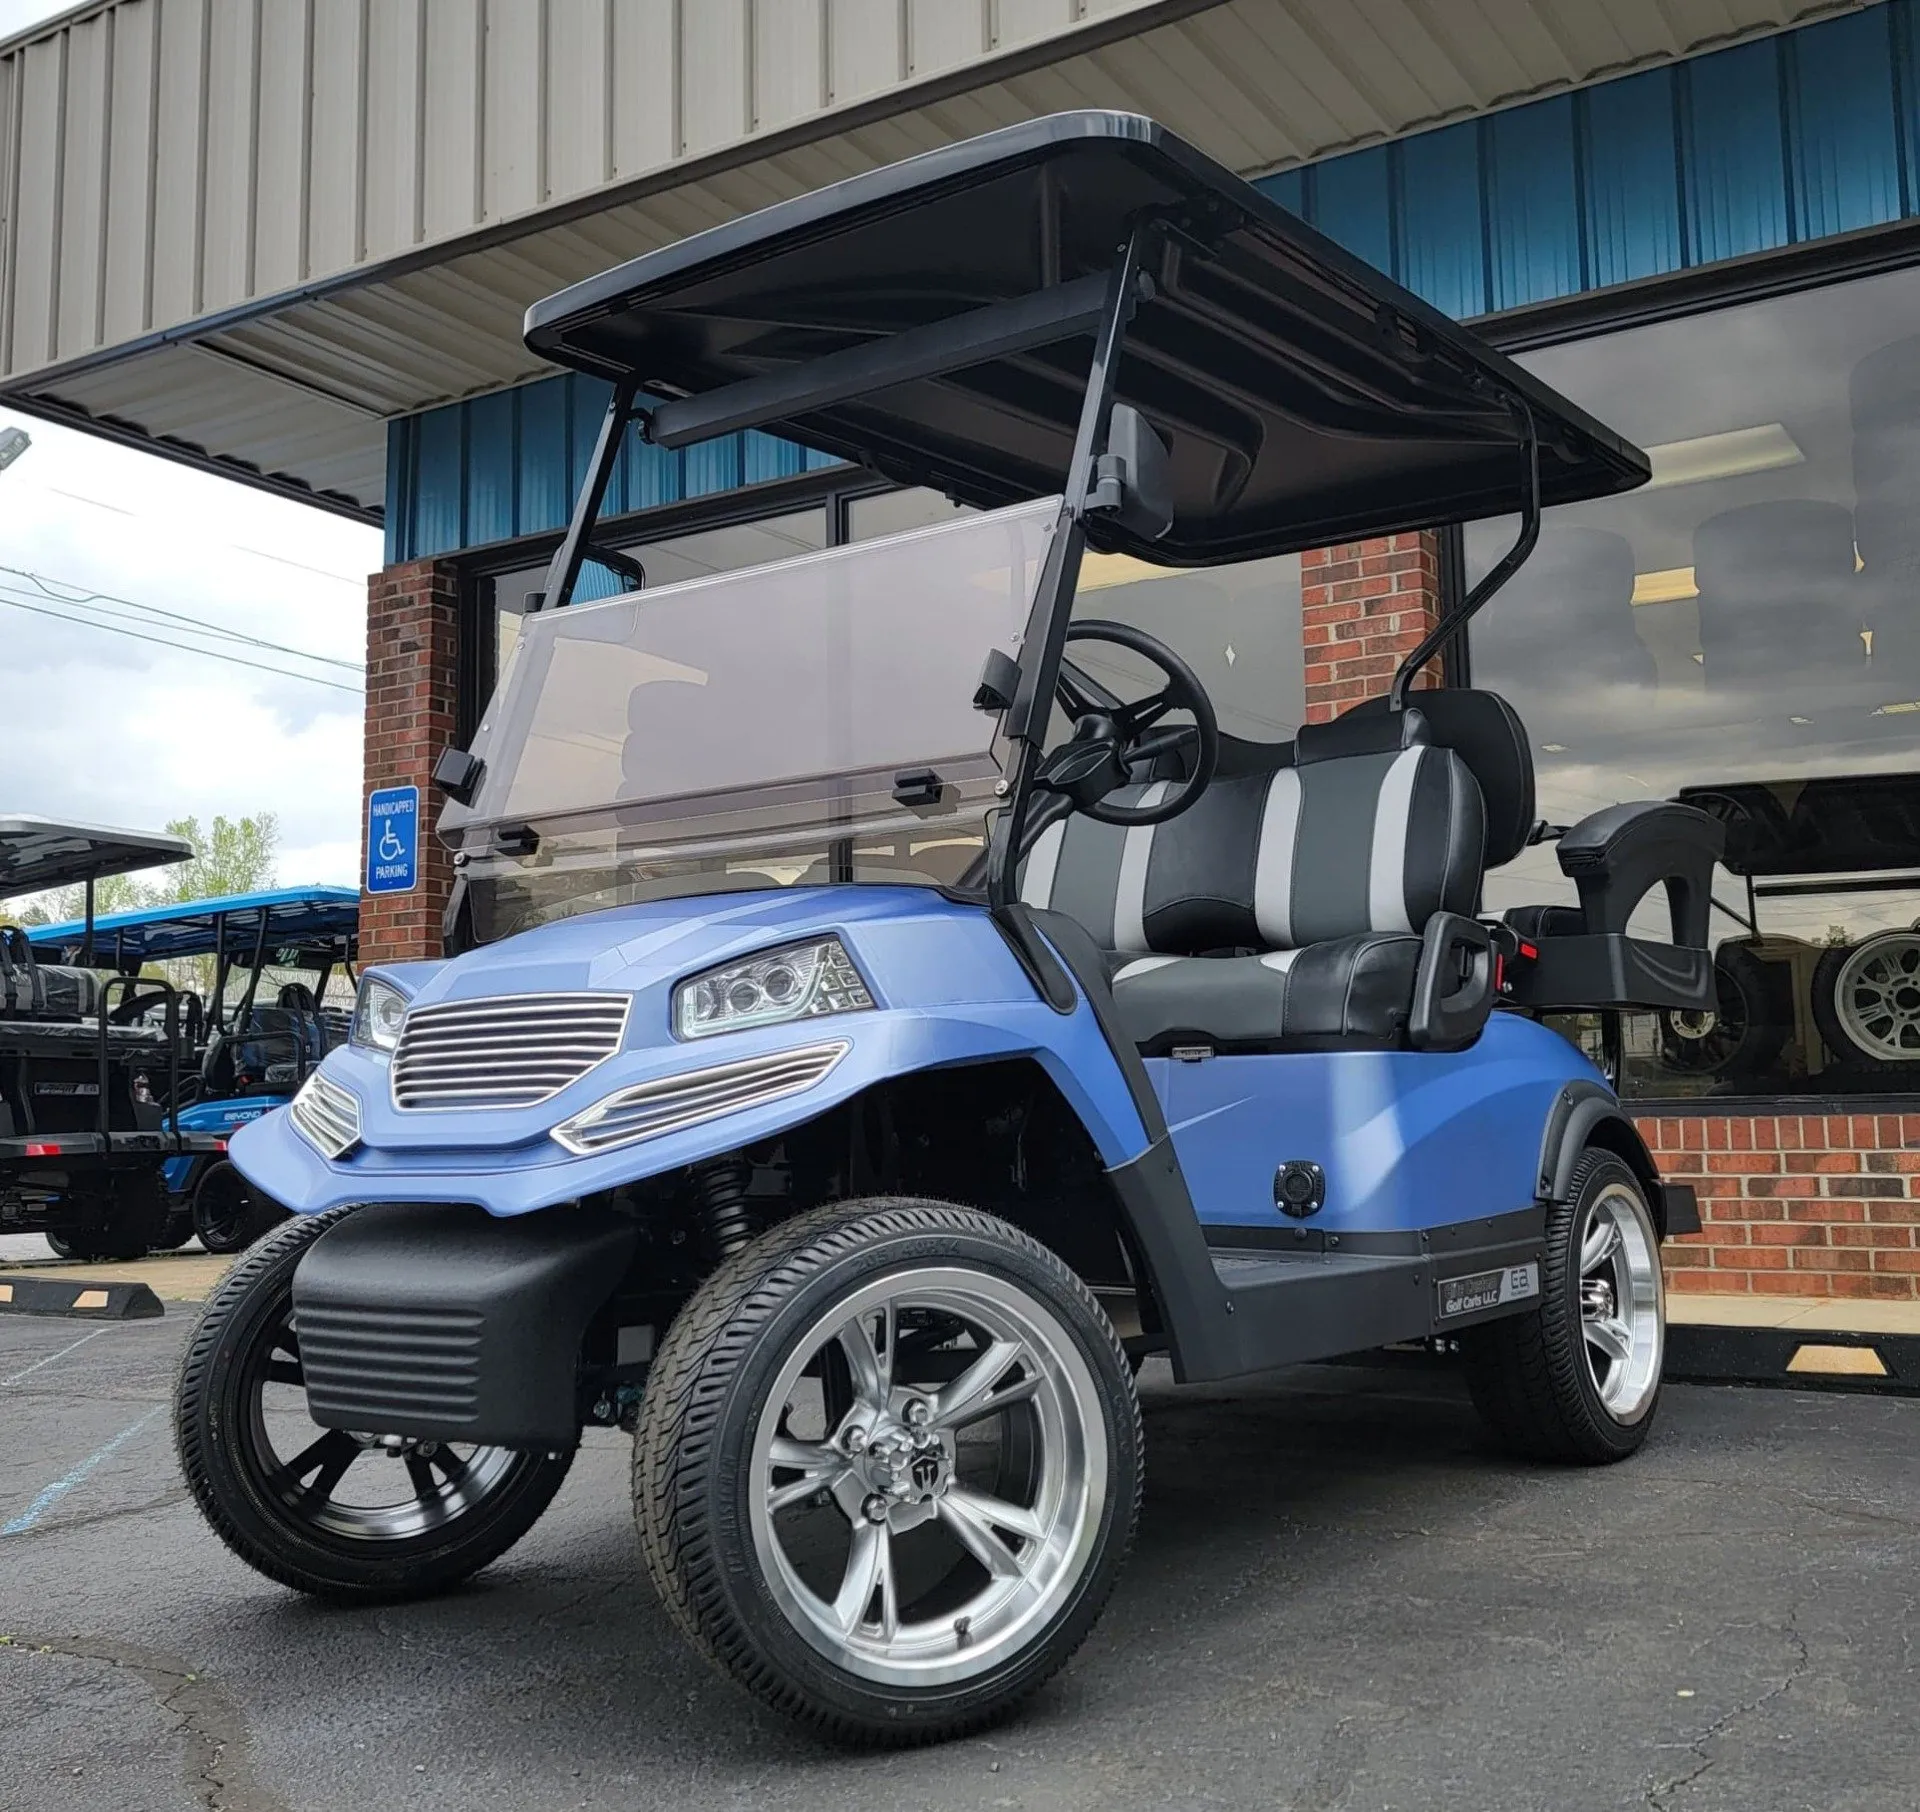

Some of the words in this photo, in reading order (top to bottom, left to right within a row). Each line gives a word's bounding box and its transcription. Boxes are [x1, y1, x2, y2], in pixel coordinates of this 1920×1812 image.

[373, 799, 415, 816] HANDICAPPED
[375, 863, 408, 879] PARKING
[1446, 1297, 1463, 1313] Golf
[1463, 1294, 1482, 1309] Carts
[1482, 1290, 1498, 1305] LLC
